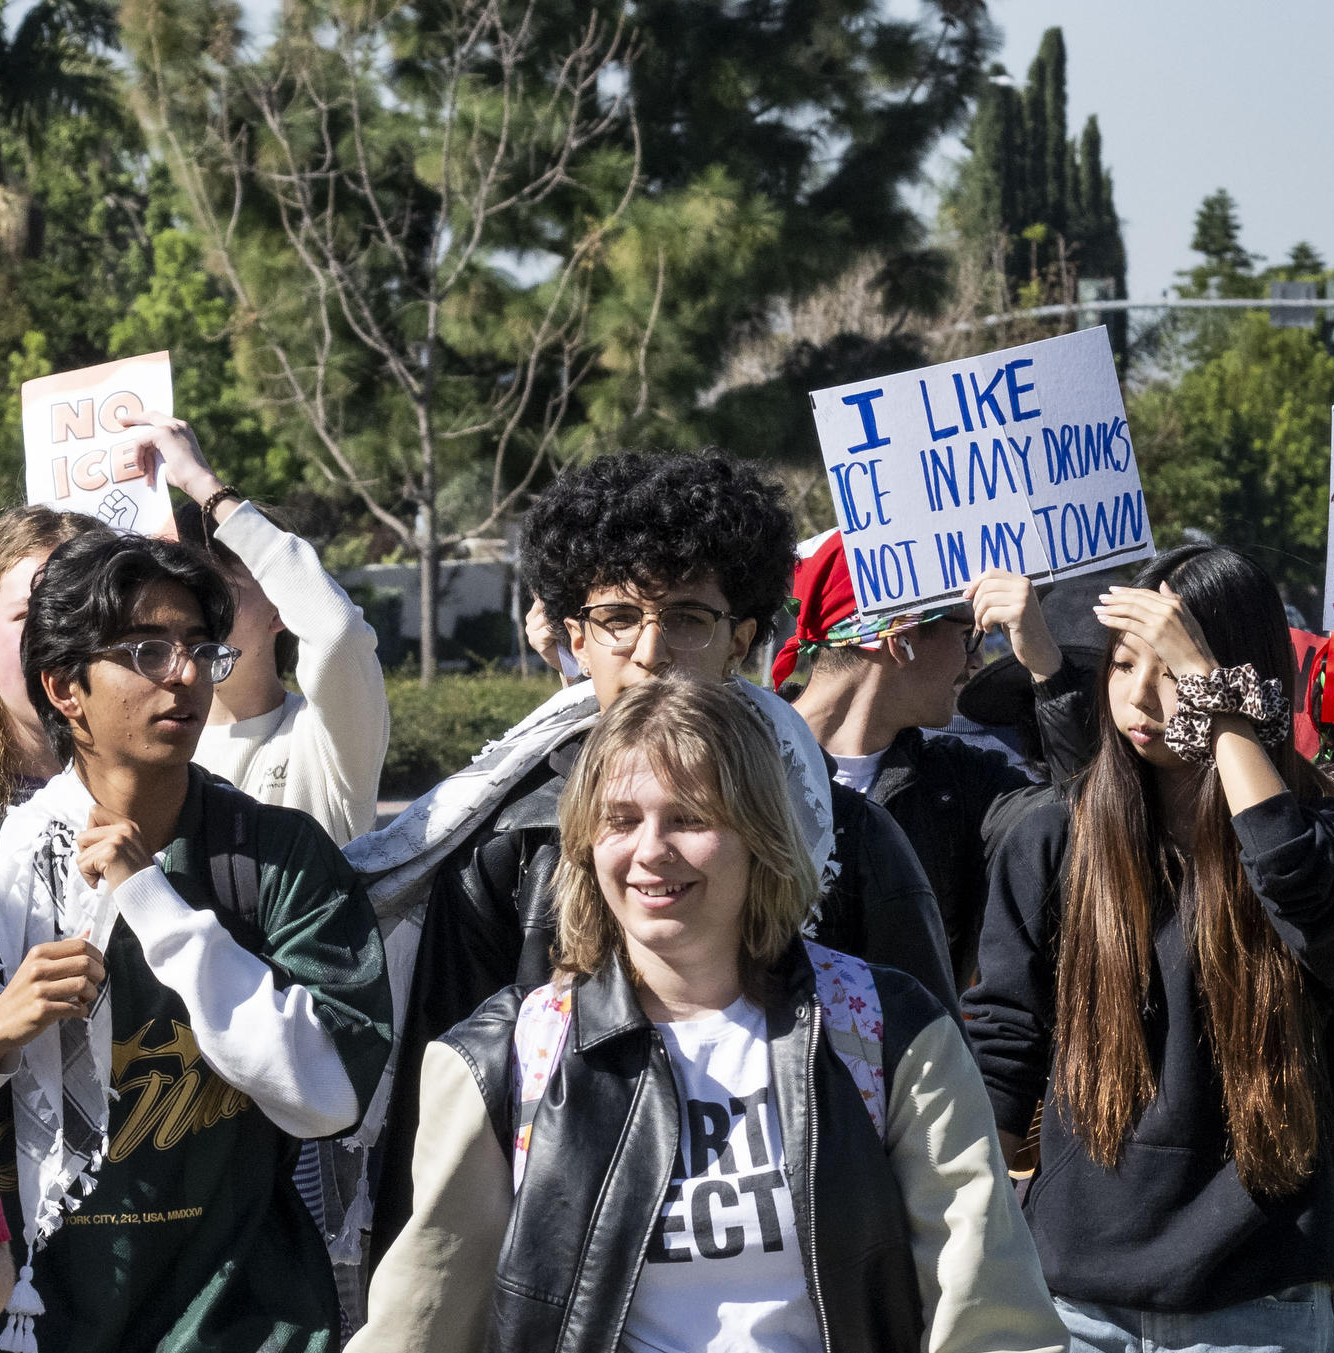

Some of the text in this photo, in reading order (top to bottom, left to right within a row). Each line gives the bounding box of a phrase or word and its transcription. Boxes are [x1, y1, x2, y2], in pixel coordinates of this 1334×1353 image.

[51, 391, 145, 443] NO
[841, 358, 1043, 455] I LIKE
[52, 438, 147, 501] ICE
[829, 415, 1132, 535] ICE IN MY DRINKS
[853, 489, 1144, 609] NOT IN MY TOWN
[93, 1213, 119, 1225] CITY,
[142, 1212, 166, 1224] USA,
